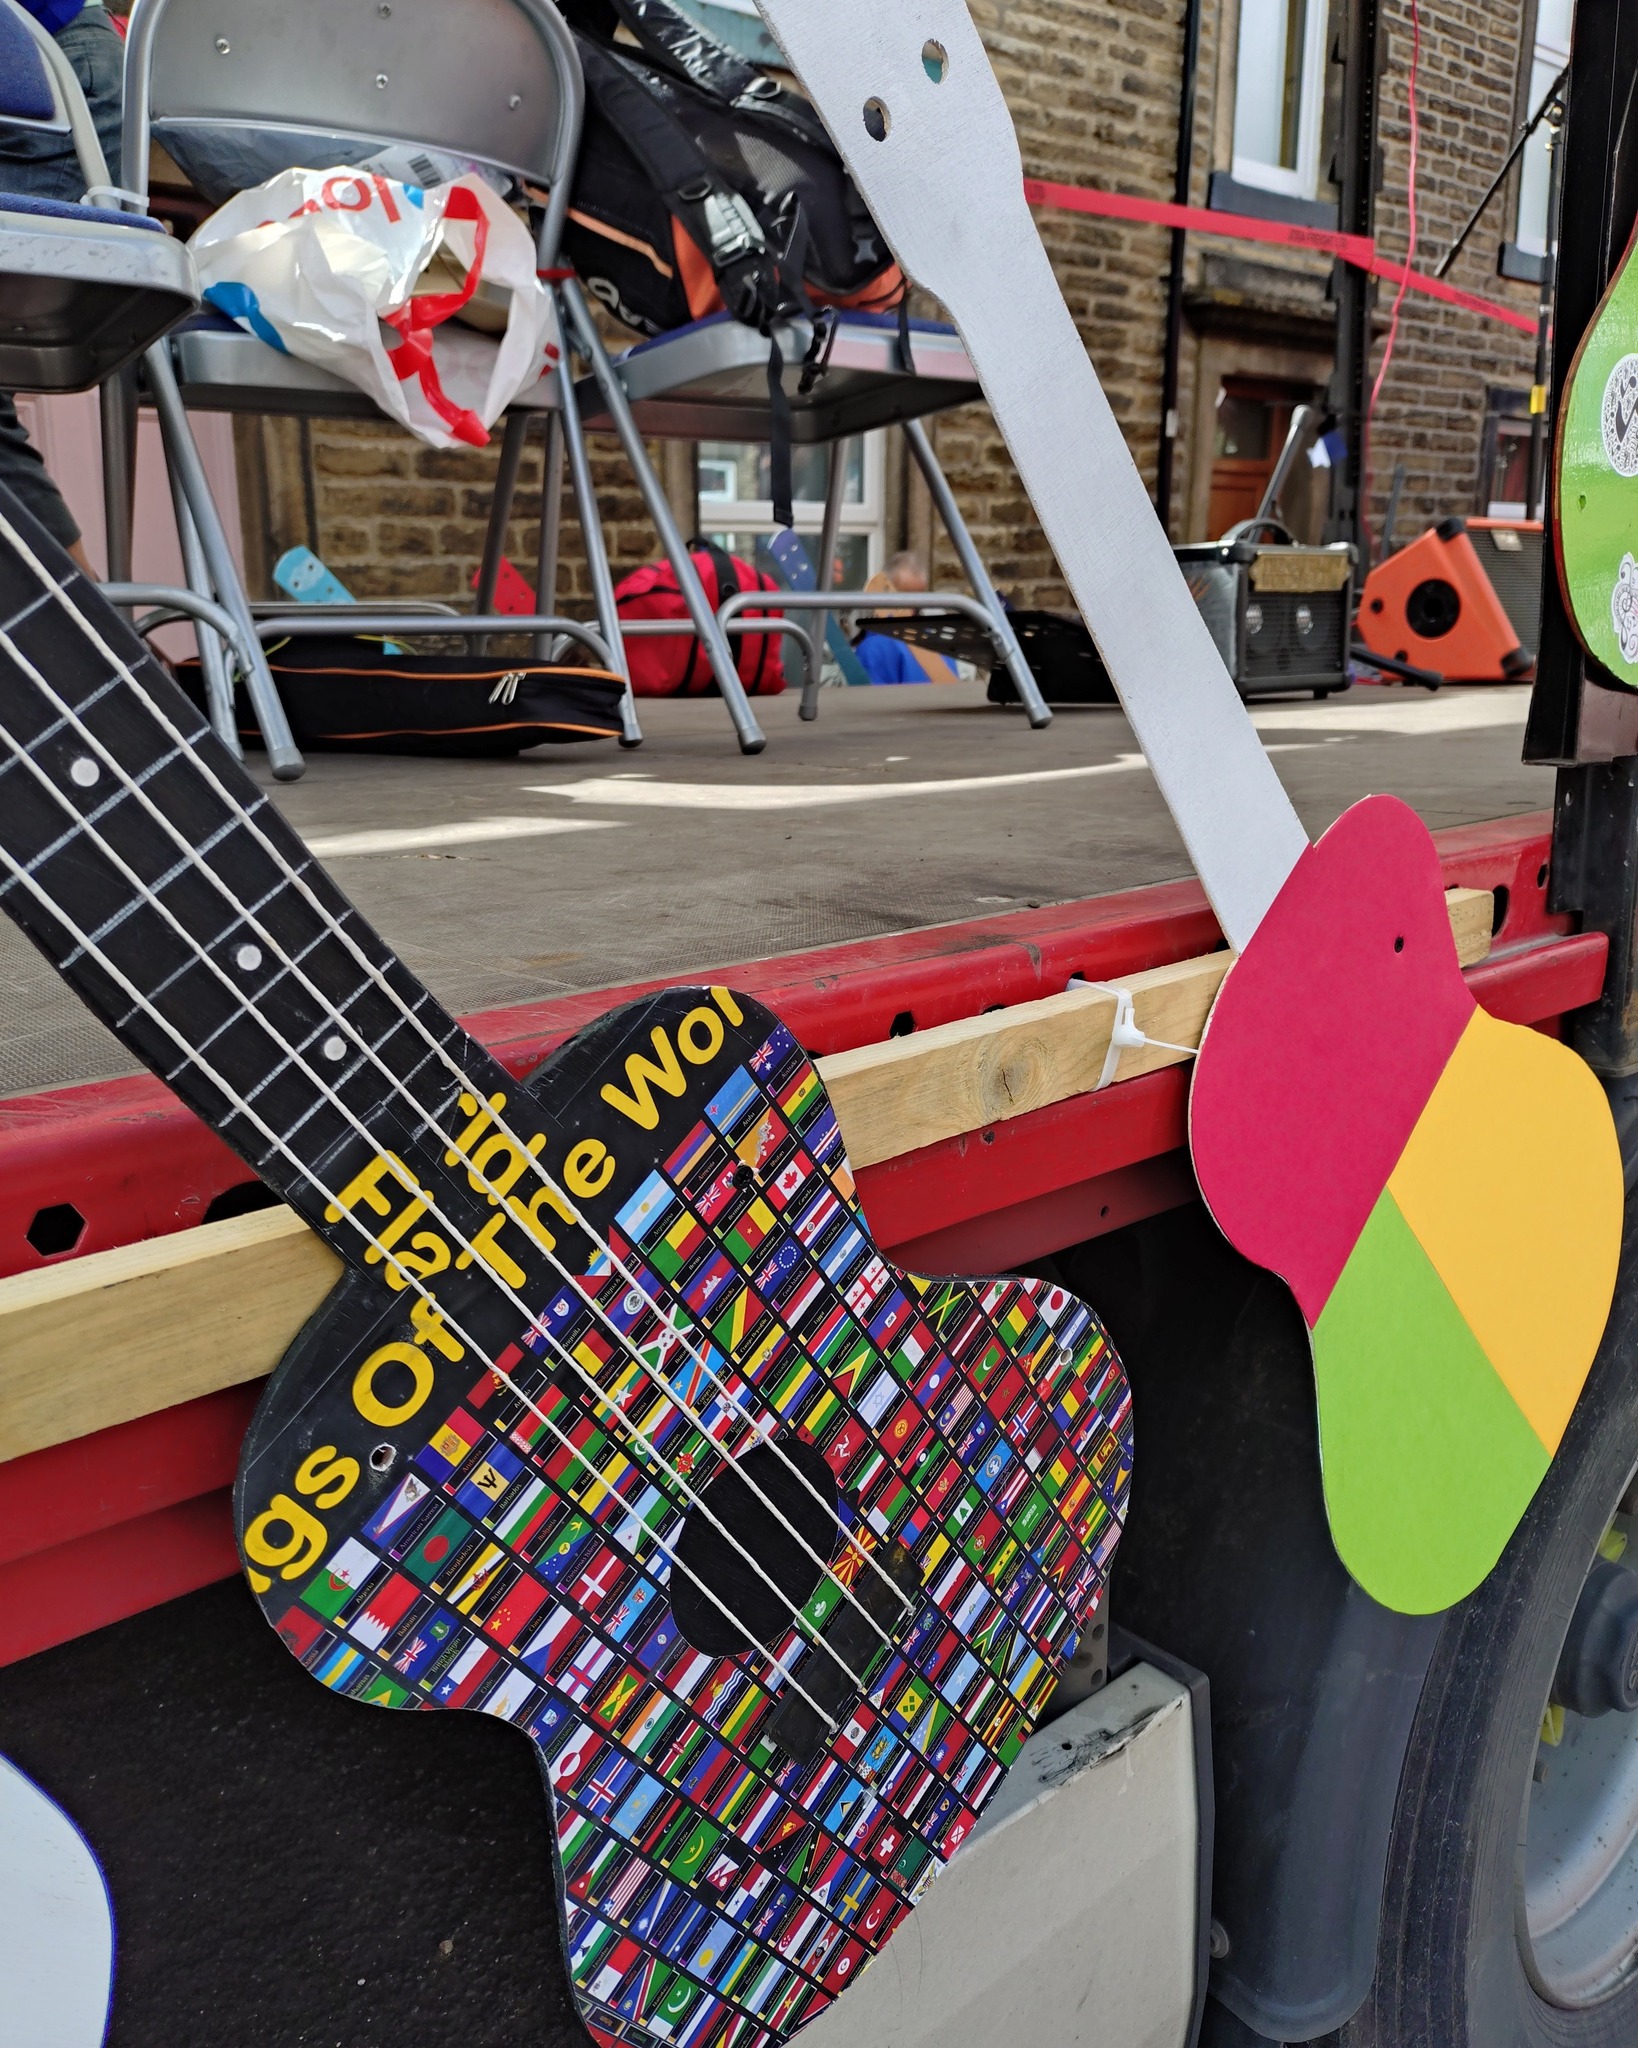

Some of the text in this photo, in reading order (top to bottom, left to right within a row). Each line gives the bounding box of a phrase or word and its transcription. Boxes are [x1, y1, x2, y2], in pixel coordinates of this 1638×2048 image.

[780, 1058, 798, 1079] Australia
[741, 1110, 755, 1127] Aruba
[809, 1101, 824, 1117] Bolivia
[697, 1159, 716, 1181] Armenia
[769, 1149, 785, 1167] Bhutan
[796, 1187, 813, 1206] Canada
[324, 1149, 452, 1291] Fla
[726, 1197, 746, 1221] Bermuda
[652, 1211, 674, 1237] Argentina
[352, 1292, 465, 1427] Of
[455, 1138, 616, 1290] The
[598, 1283, 616, 1304] Antigua
[781, 1268, 804, 1297] Cook Islands
[714, 1286, 736, 1312] Cambodia
[561, 1325, 581, 1349] Anguilla
[596, 1362, 616, 1386] Belgium
[631, 1400, 647, 1419] Burma
[462, 1449, 483, 1473] Andorra
[691, 1464, 711, 1489] Dominica
[498, 1481, 522, 1510] Barbados
[398, 1501, 439, 1550] American Samoa
[537, 1517, 558, 1541] Bulgaria
[445, 1542, 474, 1577] Bangladesh
[564, 1539, 599, 1583] Christmas Island
[354, 1580, 375, 1604] Algeria
[489, 1581, 507, 1602] Brunei
[605, 1579, 626, 1604] Denmark
[397, 1612, 418, 1637] Bahrain
[527, 1614, 543, 1632] China
[643, 1616, 652, 1627] Fiji
[431, 1636, 461, 1673] British Virgin
[441, 1647, 459, 1669] Islands
[553, 1632, 587, 1673] Czech Republic
[672, 1642, 687, 1660] Guam
[479, 1677, 494, 1694] Chile
[515, 1703, 533, 1725] Cyprus
[559, 1721, 576, 1741] Islands
[580, 1752, 603, 1782] Greenland
